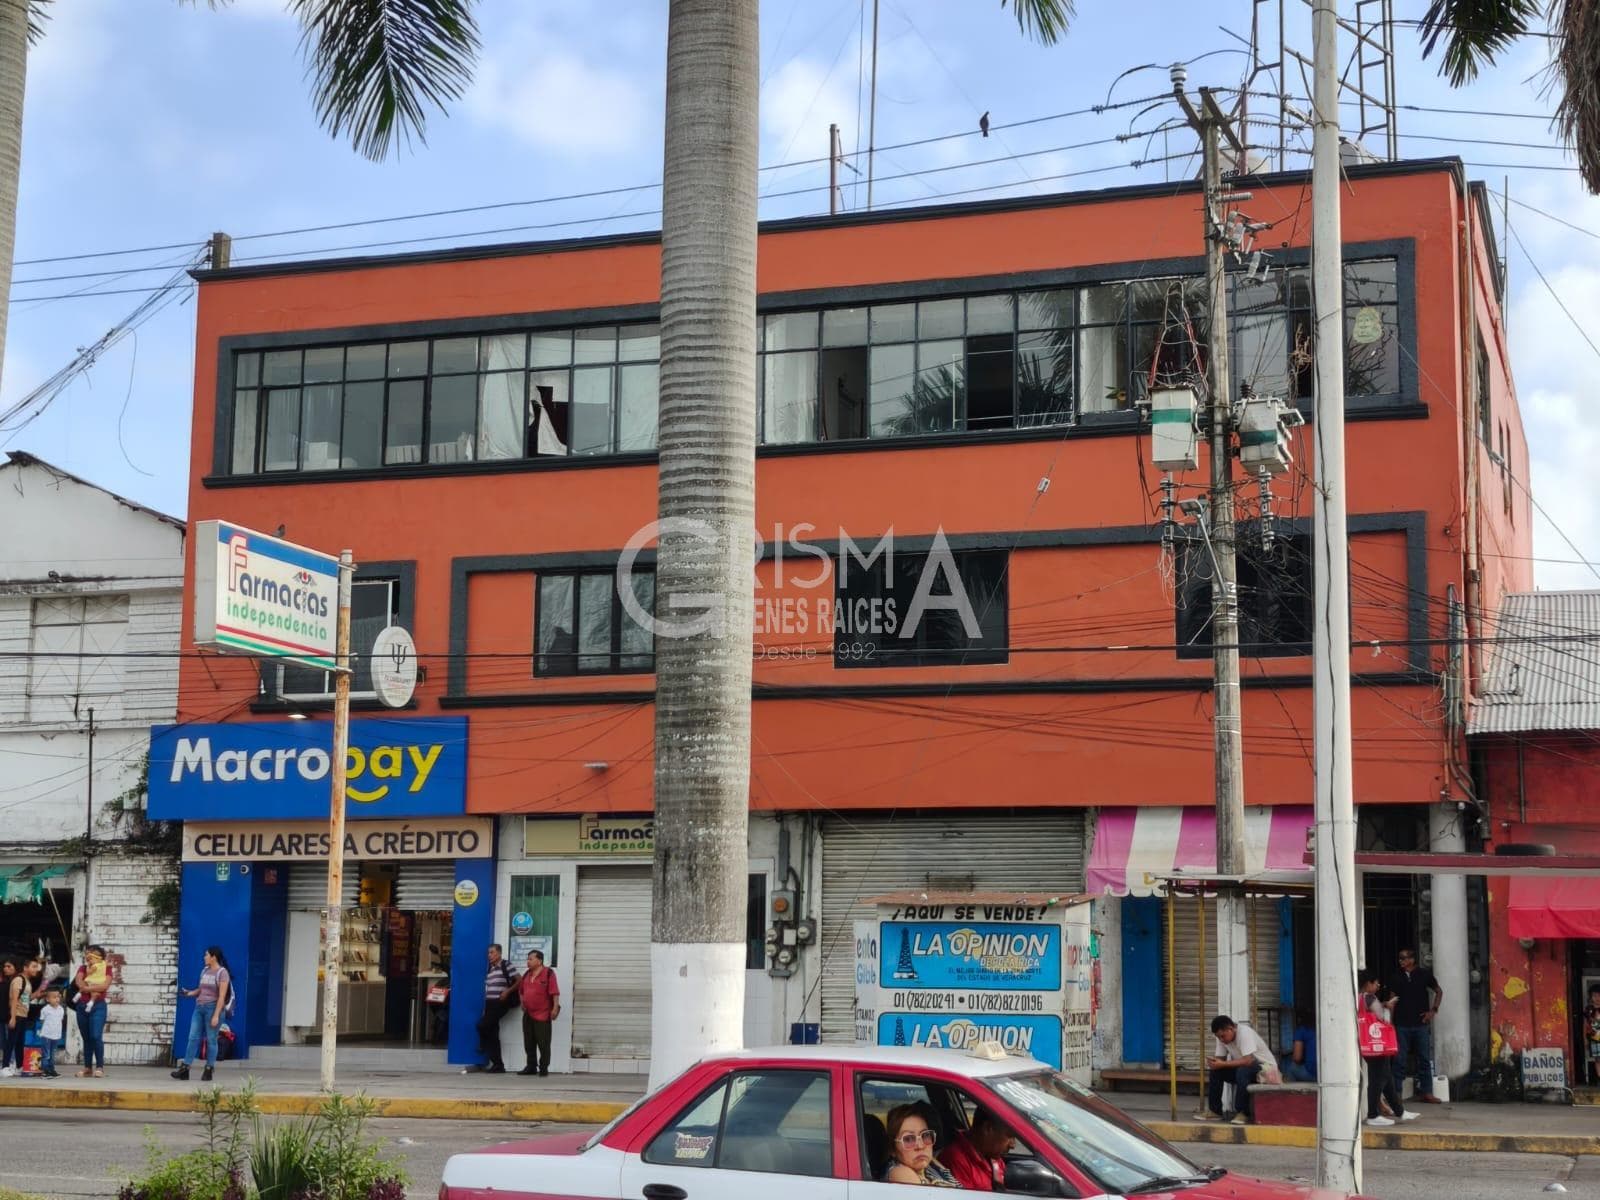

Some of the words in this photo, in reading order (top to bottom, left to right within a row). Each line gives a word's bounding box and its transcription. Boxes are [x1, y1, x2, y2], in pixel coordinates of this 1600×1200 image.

[228, 533, 328, 617] Farmacias
[194, 832, 330, 856] CELULARES
[343, 832, 358, 855] A
[364, 825, 479, 855] CRÉDITO
[954, 906, 976, 920] SE
[983, 906, 1047, 921] VENDE!
[912, 933, 944, 956] LA
[950, 933, 1049, 957] OPINION
[911, 1024, 943, 1048] LA
[948, 1023, 1034, 1050] OPINION
[1523, 1053, 1563, 1069] BAÑOS
